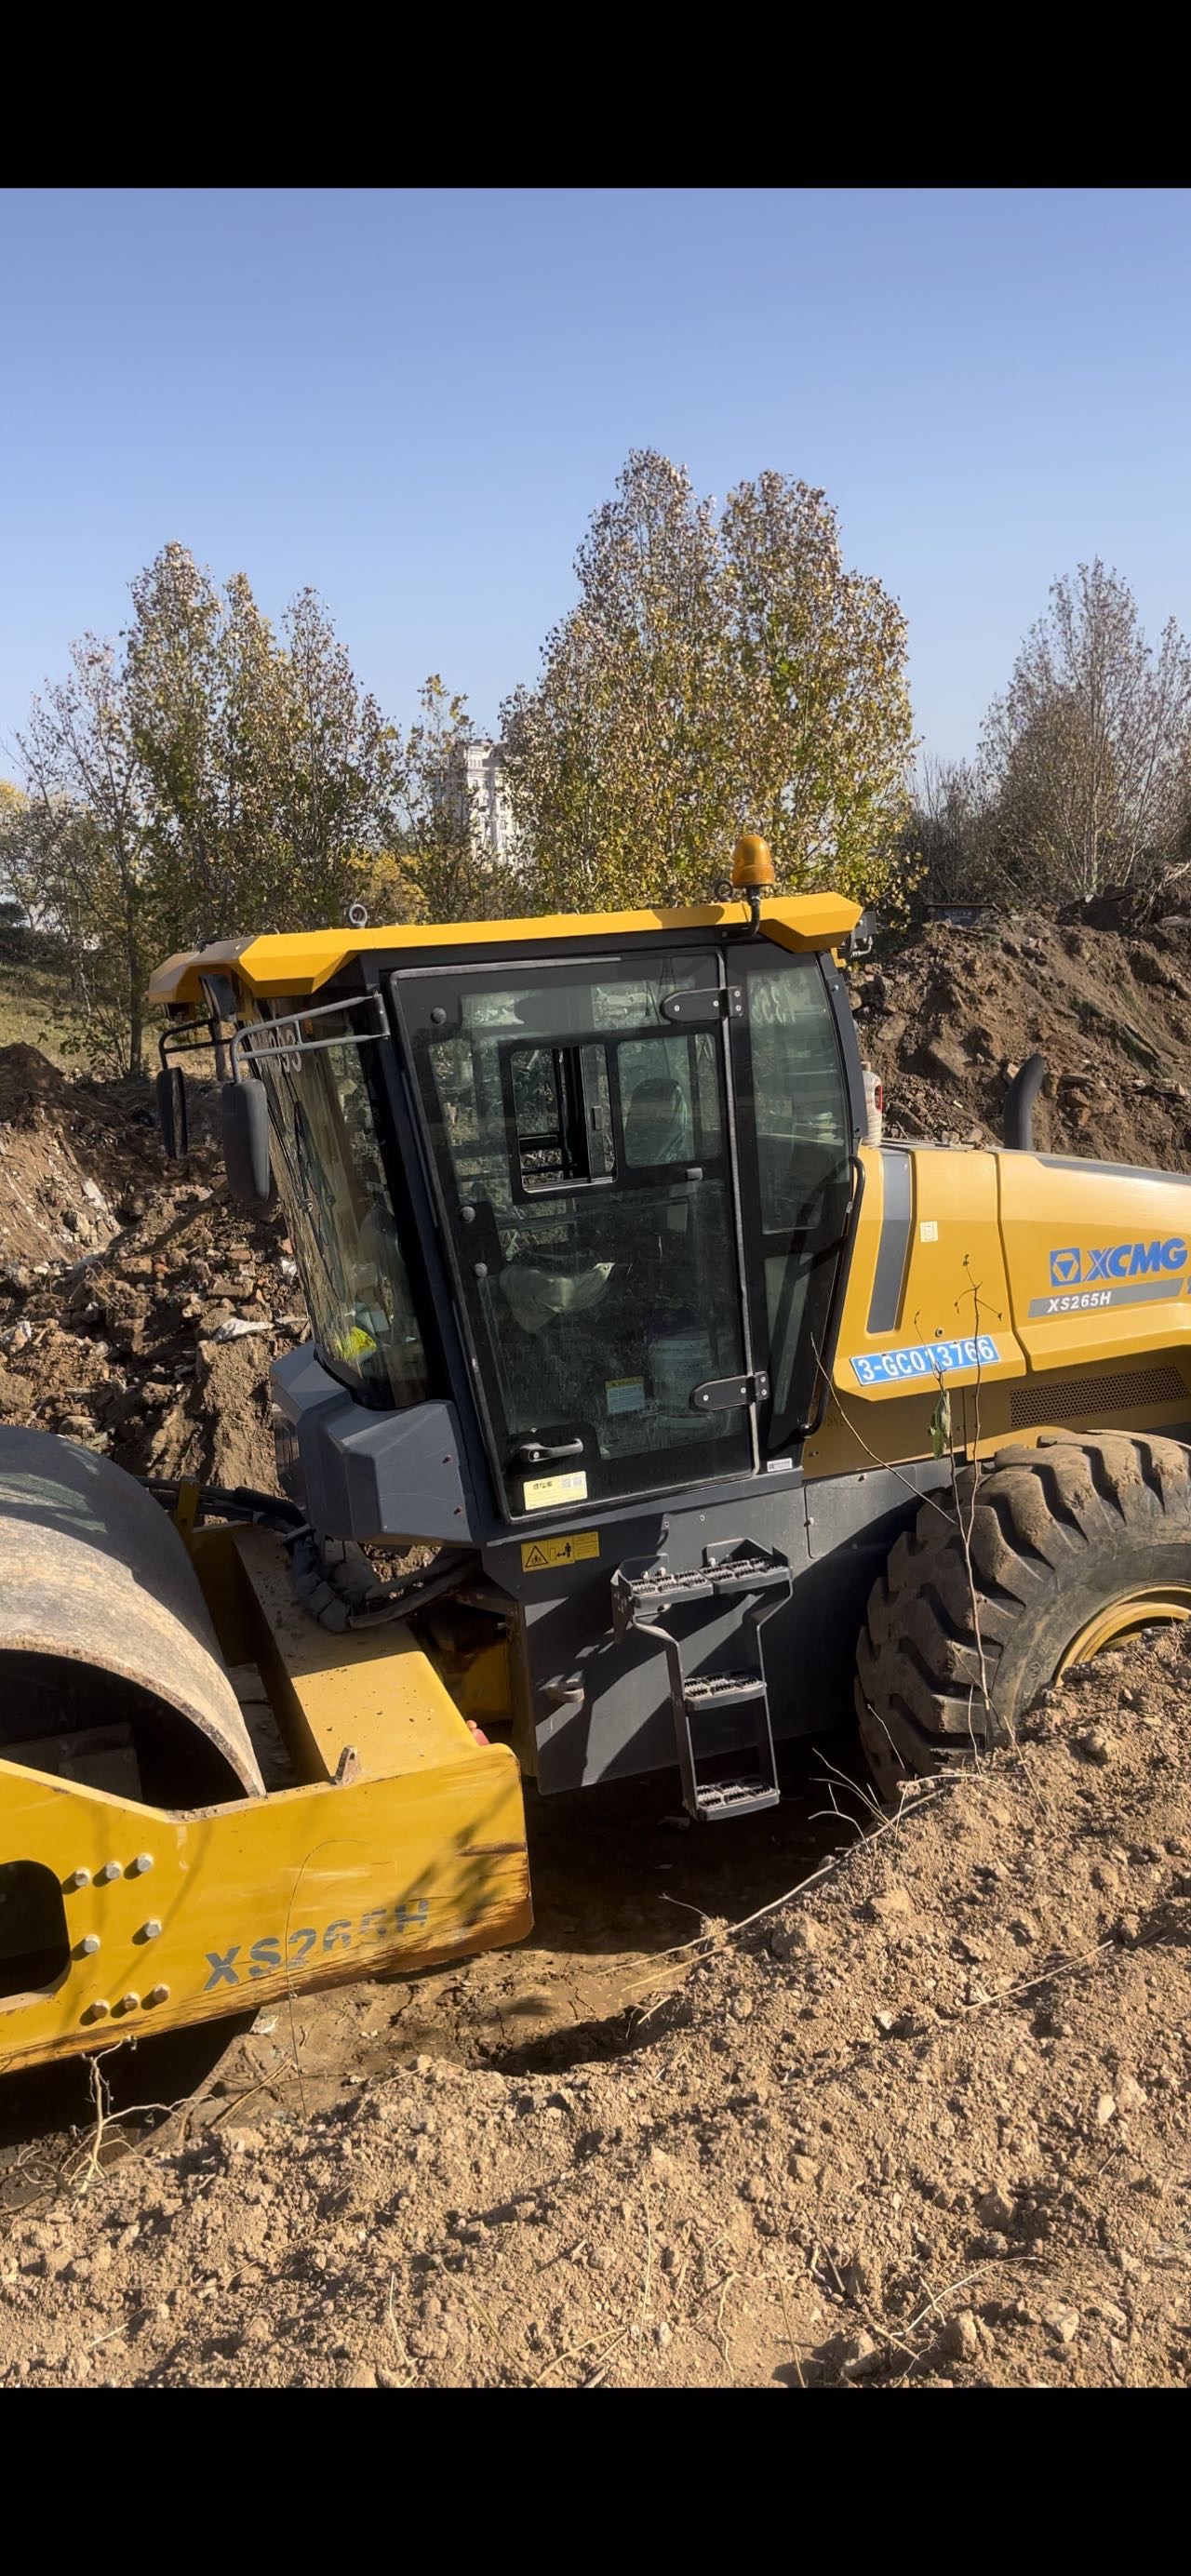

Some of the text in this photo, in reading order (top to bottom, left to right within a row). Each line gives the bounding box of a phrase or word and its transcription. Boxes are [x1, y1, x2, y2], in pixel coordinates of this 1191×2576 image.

[1083, 1237, 1188, 1281] XCMG
[1047, 1290, 1112, 1314] XS265H
[857, 1338, 995, 1381] 3-GC013766
